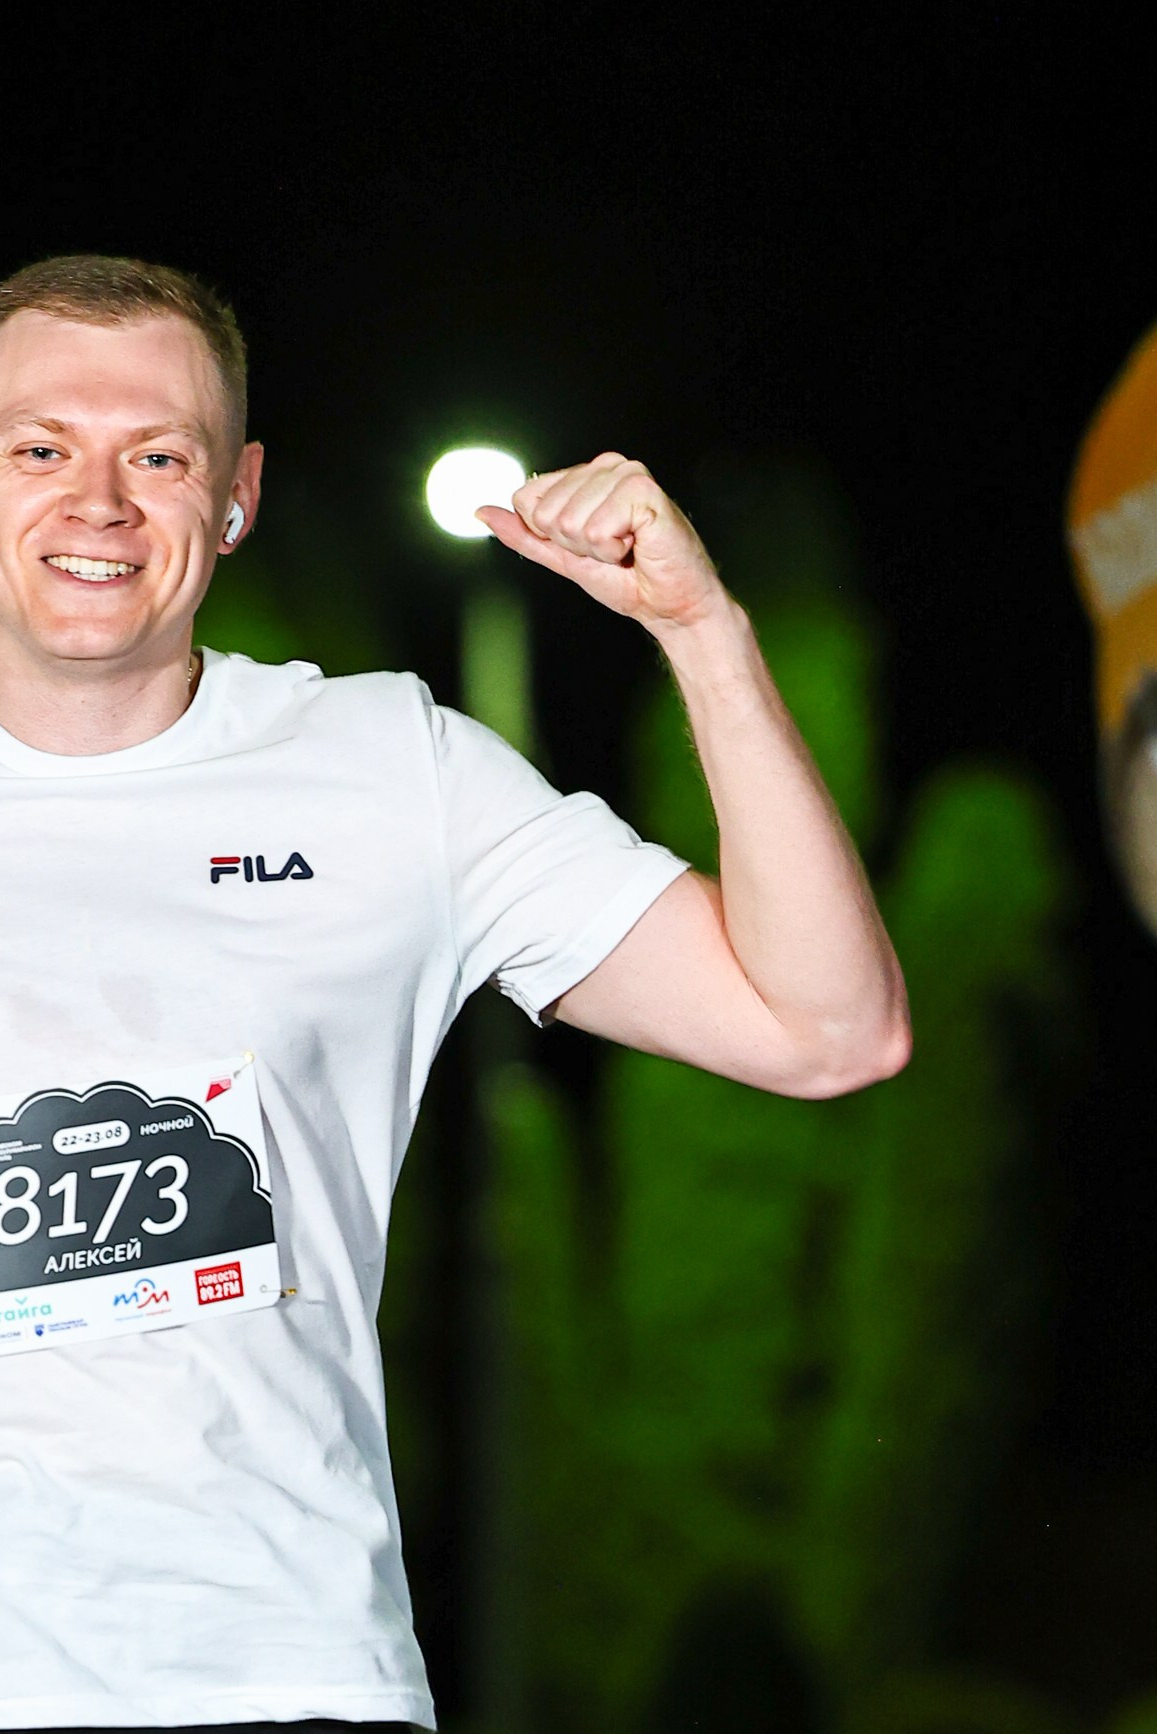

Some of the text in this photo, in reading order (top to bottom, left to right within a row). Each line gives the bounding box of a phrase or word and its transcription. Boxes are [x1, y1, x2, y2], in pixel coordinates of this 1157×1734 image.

[210, 852, 314, 884] FILA
[43, 1237, 142, 1275] АЛЕКСЕЙ
[223, 1280, 241, 1297] FM
